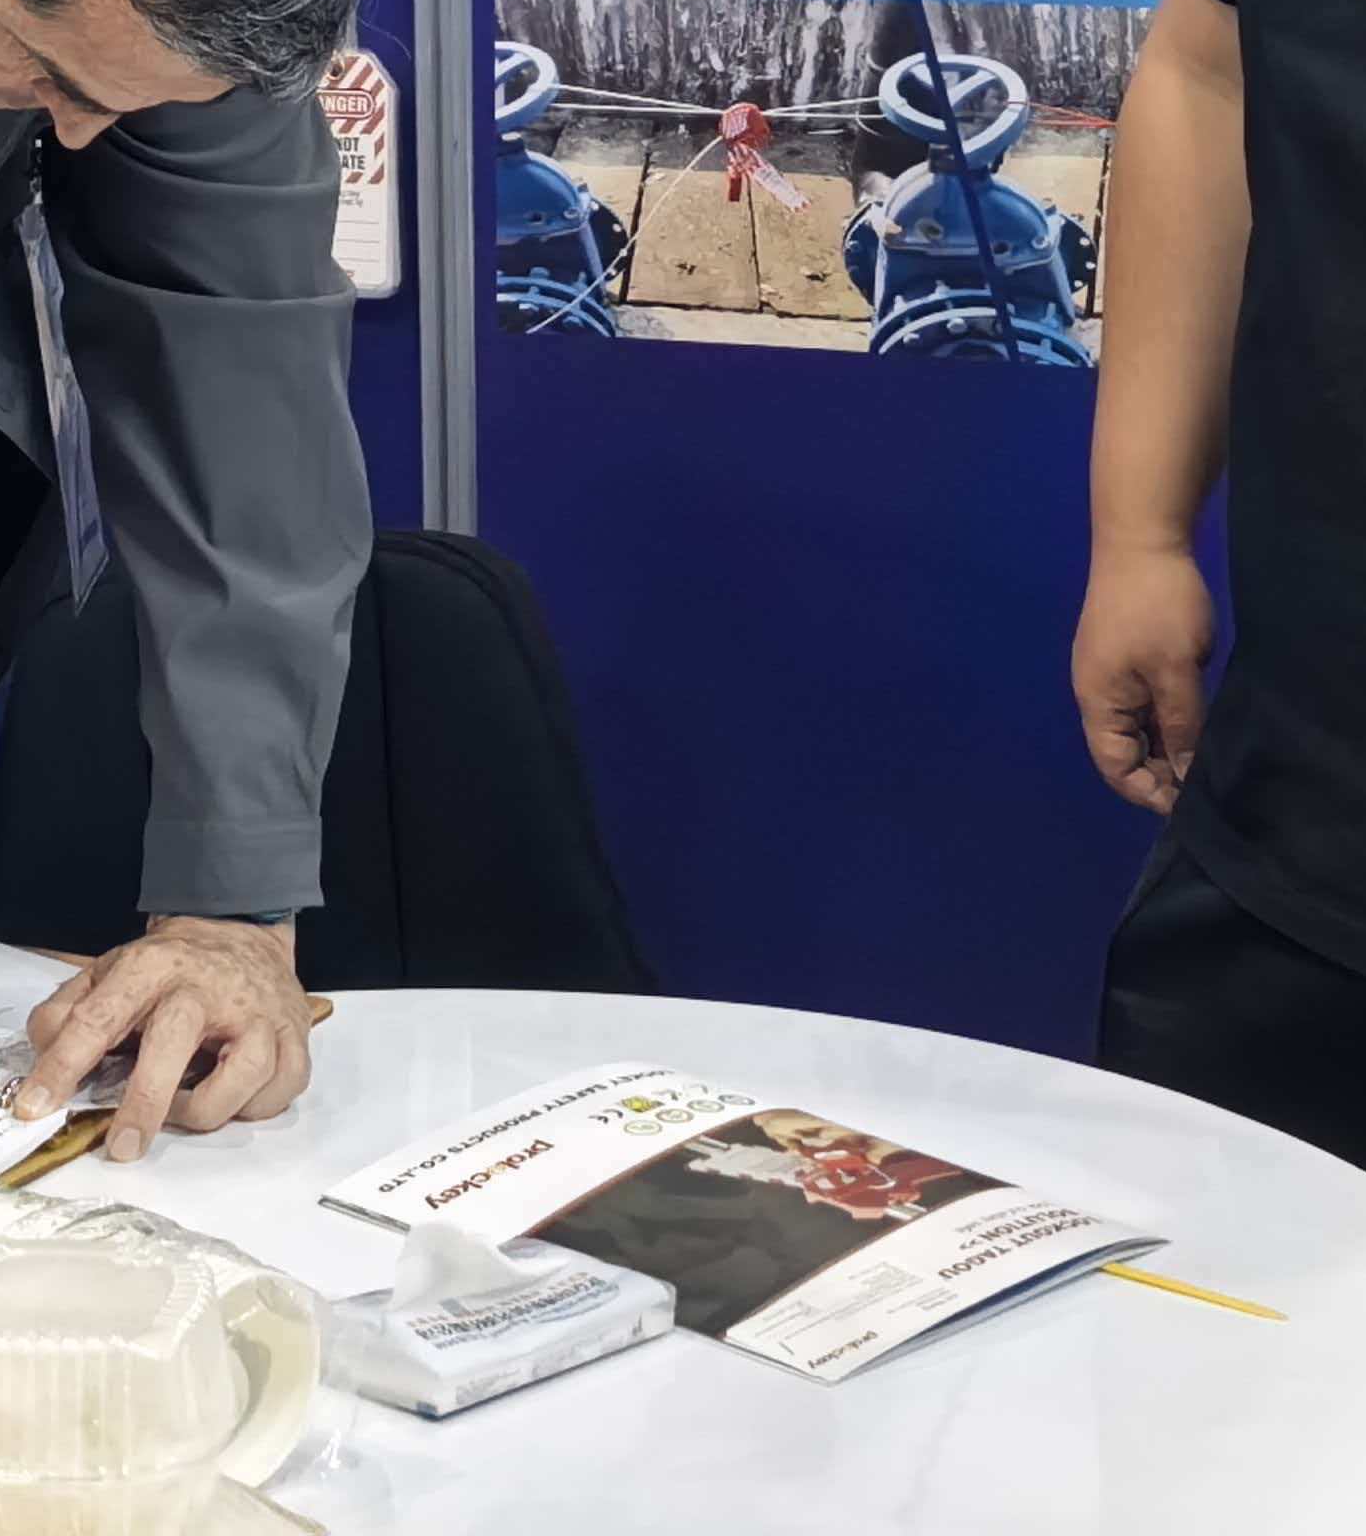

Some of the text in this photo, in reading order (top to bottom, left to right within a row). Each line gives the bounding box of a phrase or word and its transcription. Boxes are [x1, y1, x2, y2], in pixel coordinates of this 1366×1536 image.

[319, 95, 368, 113] NGER
[447, 1109, 543, 1154] PRODUCTS
[424, 1138, 555, 1210] prolockey
